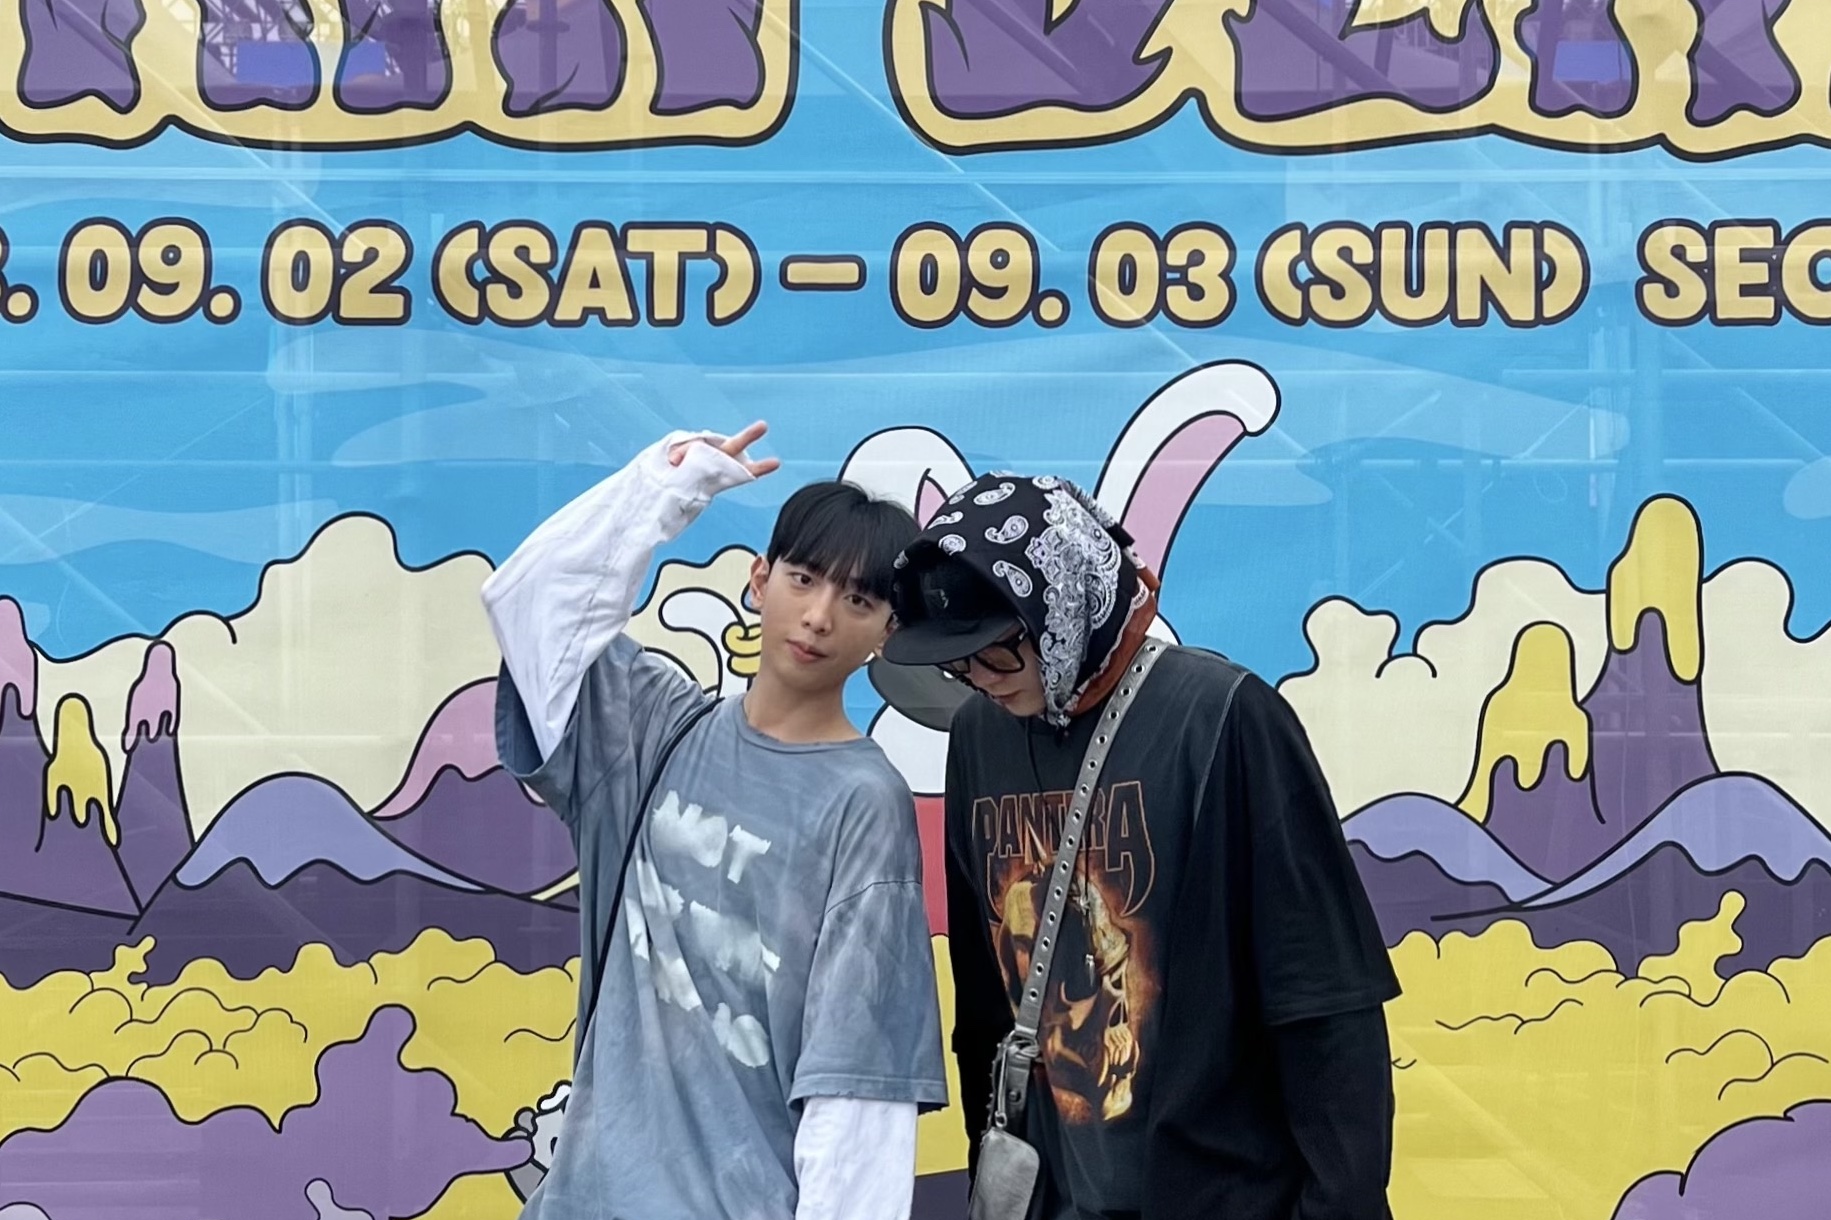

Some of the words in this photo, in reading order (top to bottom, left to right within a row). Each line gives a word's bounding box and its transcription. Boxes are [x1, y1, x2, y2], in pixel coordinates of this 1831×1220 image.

[59, 216, 241, 325] 09.
[262, 217, 412, 325] 02
[432, 220, 761, 328] (SAT)
[889, 221, 1070, 328] 09.
[1089, 221, 1238, 328] 03
[1255, 221, 1591, 328] (SUN)
[972, 780, 1155, 921] PANTRA
